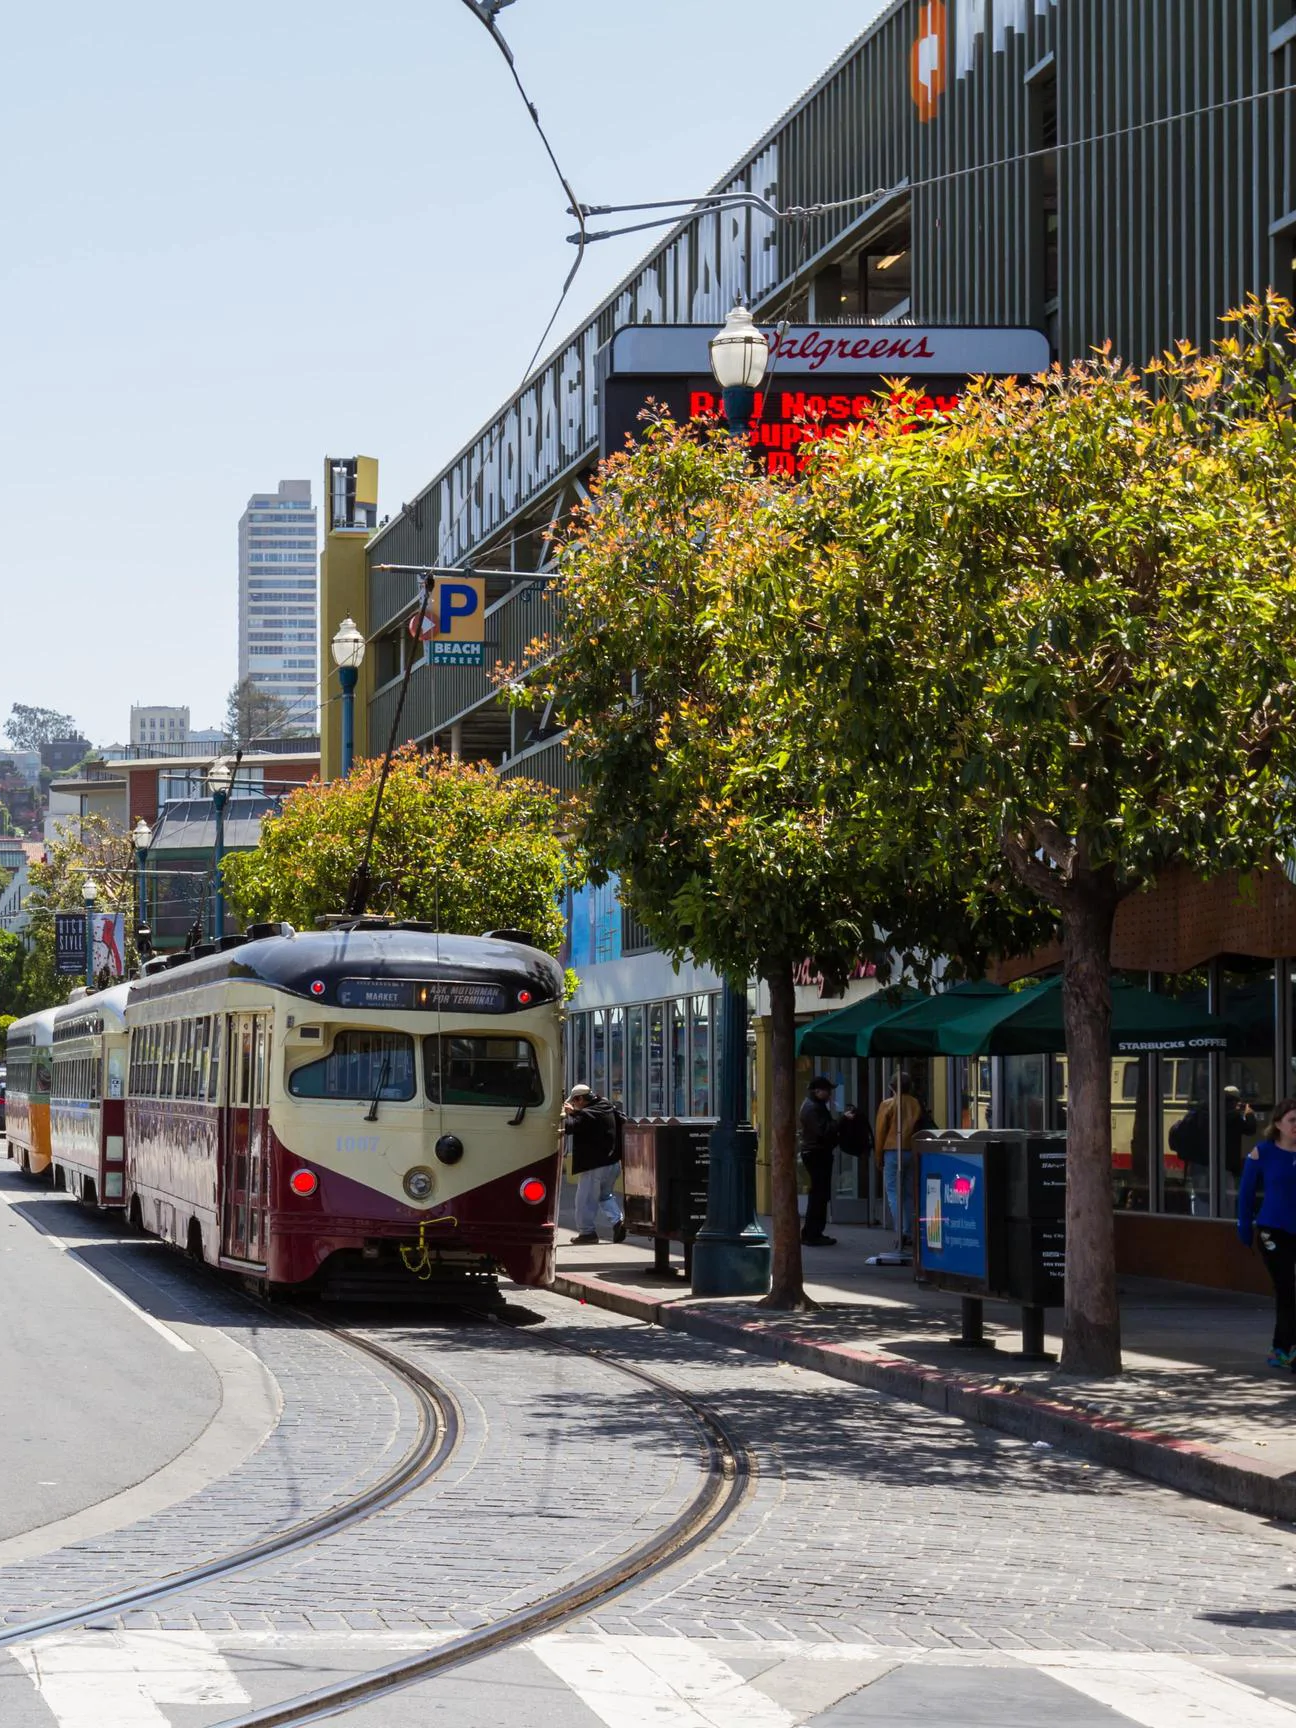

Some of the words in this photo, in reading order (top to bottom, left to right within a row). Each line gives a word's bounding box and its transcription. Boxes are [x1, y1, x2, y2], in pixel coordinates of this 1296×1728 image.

[440, 584, 478, 633] P
[435, 642, 481, 655] BEACH
[434, 656, 480, 665] STREET
[59, 919, 82, 934] HIGH
[59, 935, 82, 950] STYLE
[429, 984, 447, 996] ASK
[449, 985, 499, 997] MOTORMAN
[365, 991, 398, 1002] MARKET
[432, 994, 450, 1006] FOR
[453, 995, 495, 1007] TERMINAL
[1118, 1041, 1185, 1051] STARBUCKS
[1188, 1038, 1227, 1047] COFFEE
